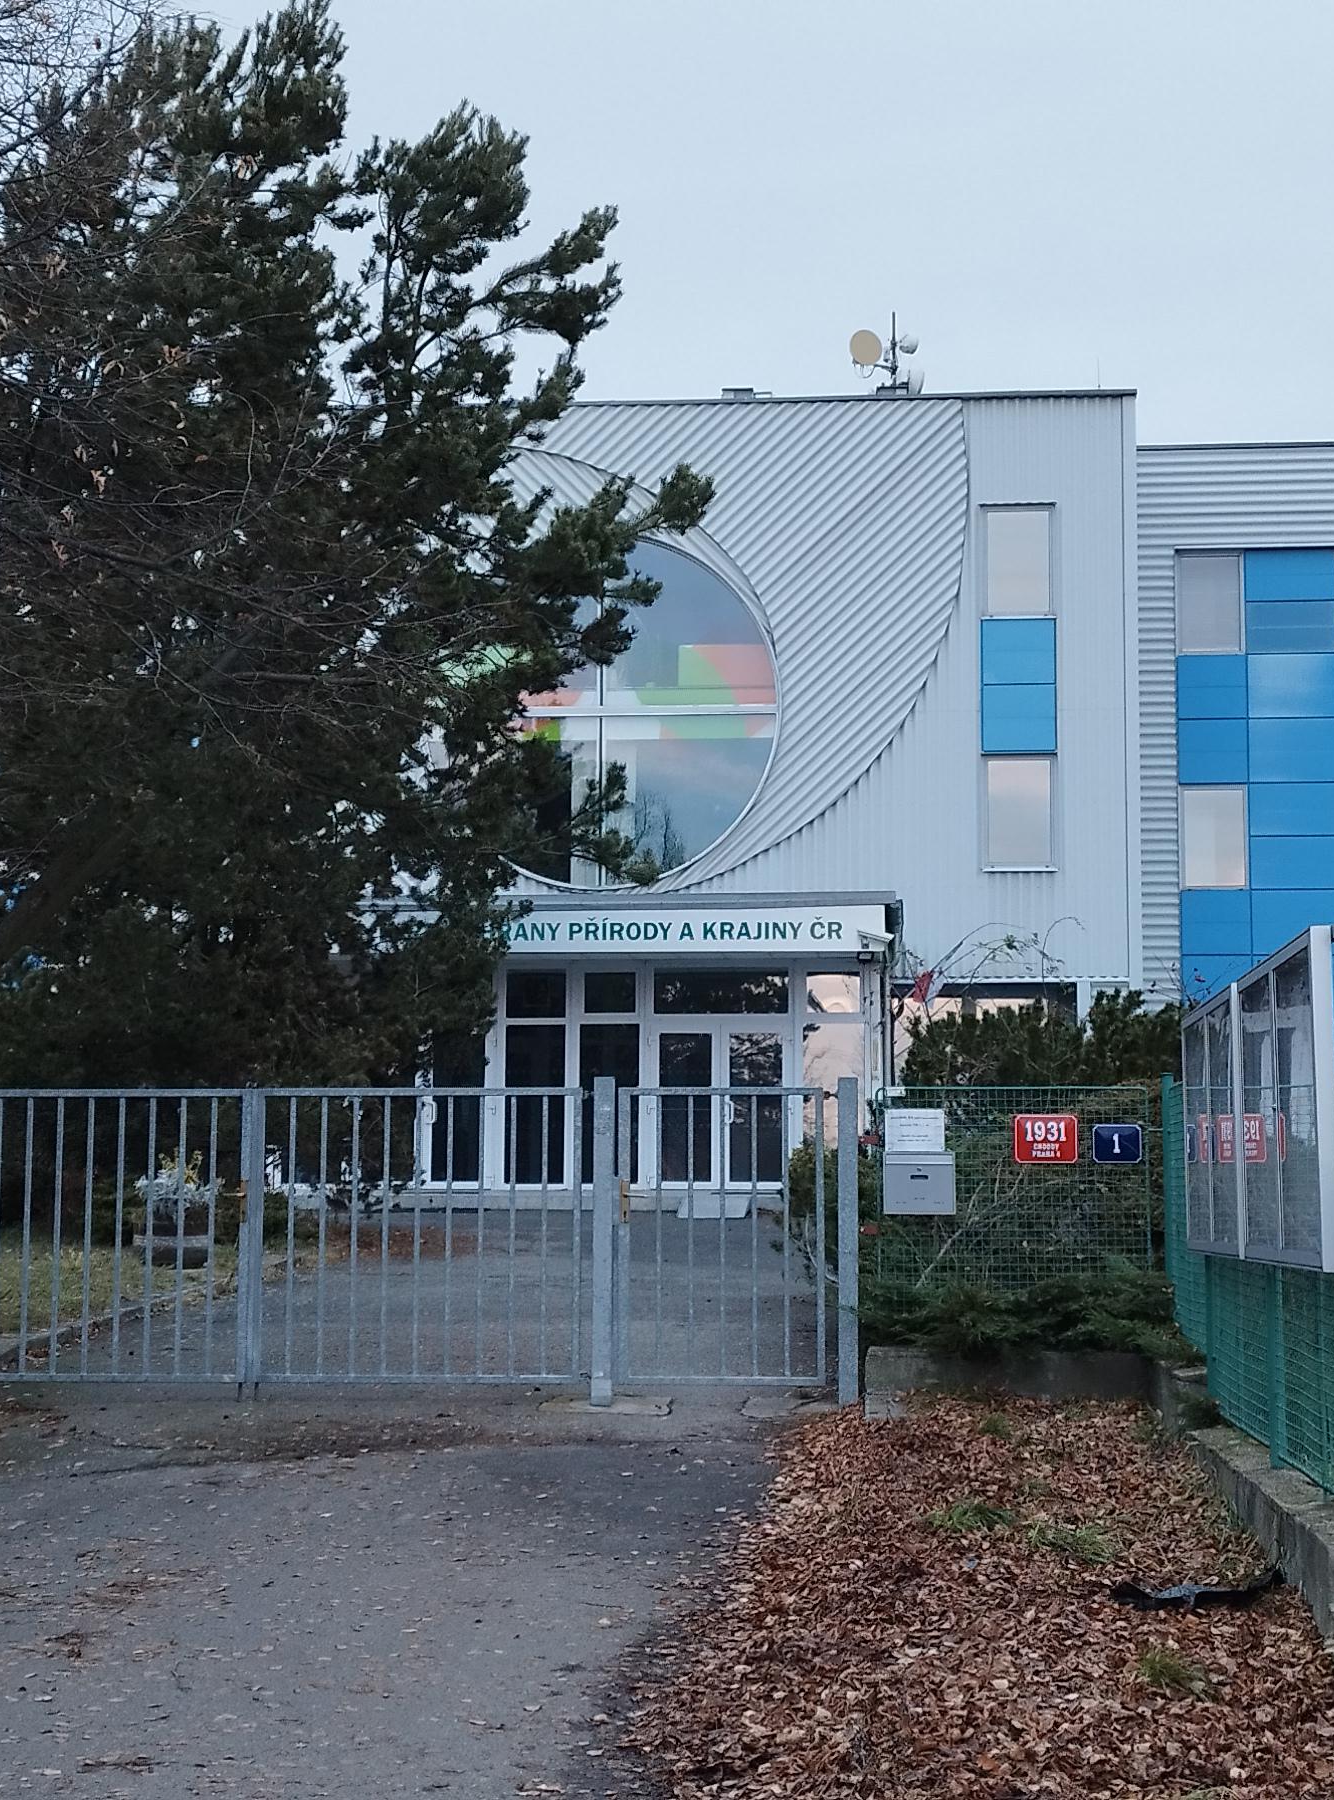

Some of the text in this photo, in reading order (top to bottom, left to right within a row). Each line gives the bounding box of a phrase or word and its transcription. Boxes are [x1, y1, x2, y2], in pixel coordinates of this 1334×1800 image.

[567, 917, 672, 941] PŘÍRODY
[679, 922, 695, 941] A
[703, 921, 803, 940] KRAJINY
[810, 916, 843, 940] ČR
[1024, 1120, 1067, 1142] 1931
[1112, 1133, 1121, 1154] 1
